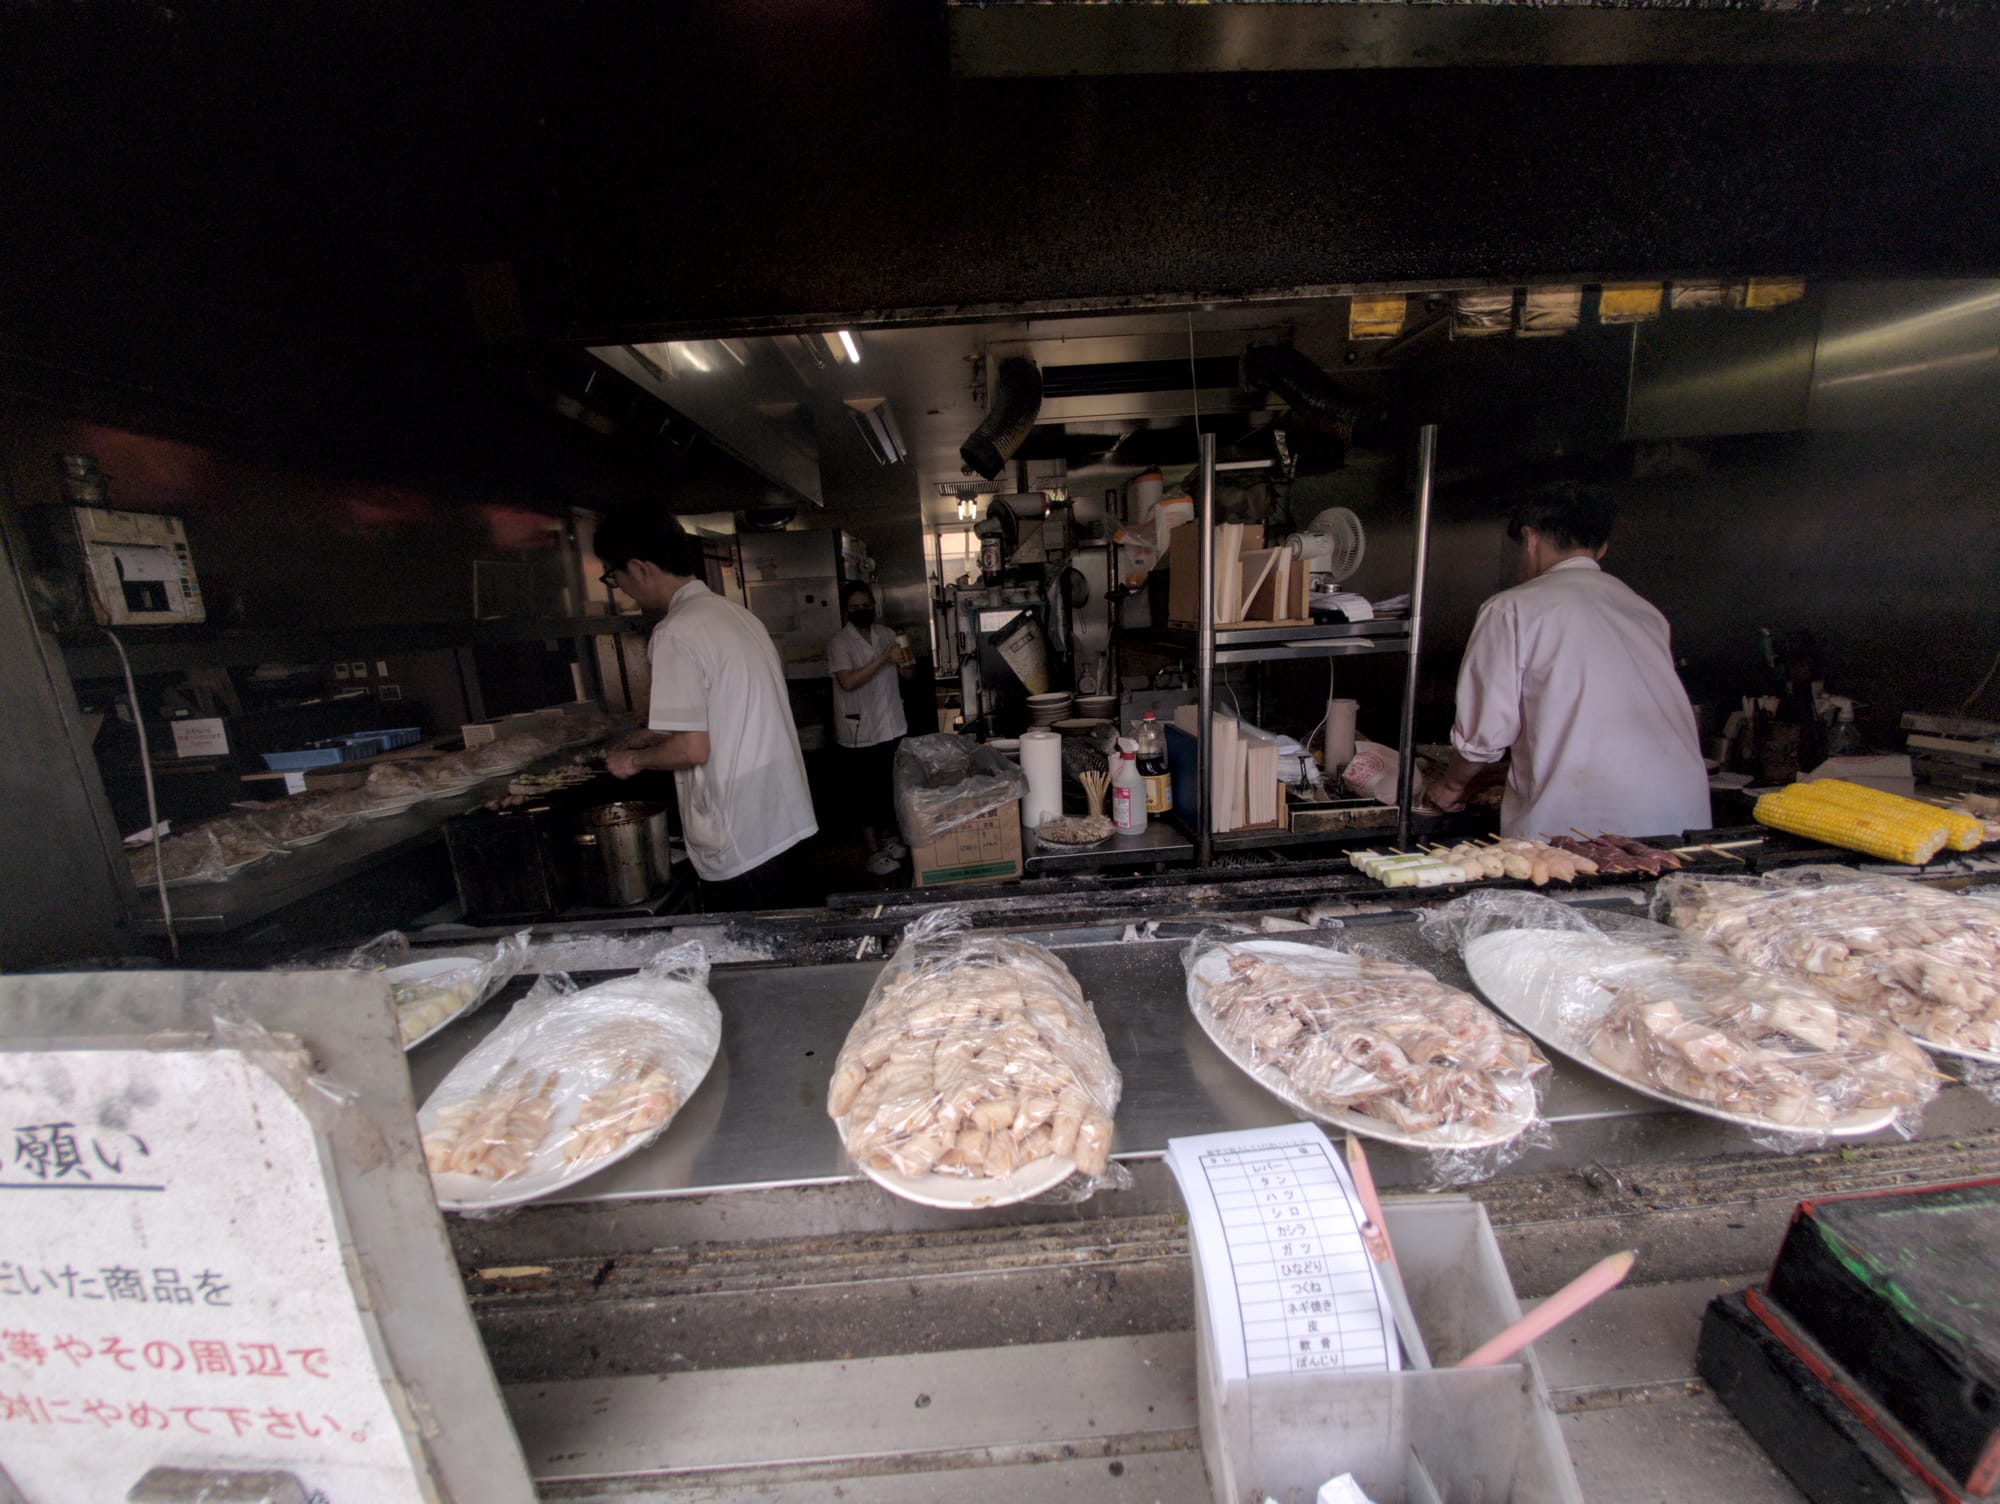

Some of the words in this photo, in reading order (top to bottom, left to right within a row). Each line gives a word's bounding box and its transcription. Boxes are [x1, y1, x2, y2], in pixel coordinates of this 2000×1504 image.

[0, 1122, 150, 1180] 願い
[1252, 1162, 1283, 1173] レバー
[1261, 1175, 1287, 1186] タン
[1266, 1190, 1294, 1201] ハツ
[1271, 1206, 1300, 1219] シロ
[1277, 1223, 1307, 1237] カシラ
[1281, 1260, 1322, 1277] ひなどり
[1290, 1280, 1322, 1295] つくね
[0, 1329, 330, 1379] 等やその周辺で
